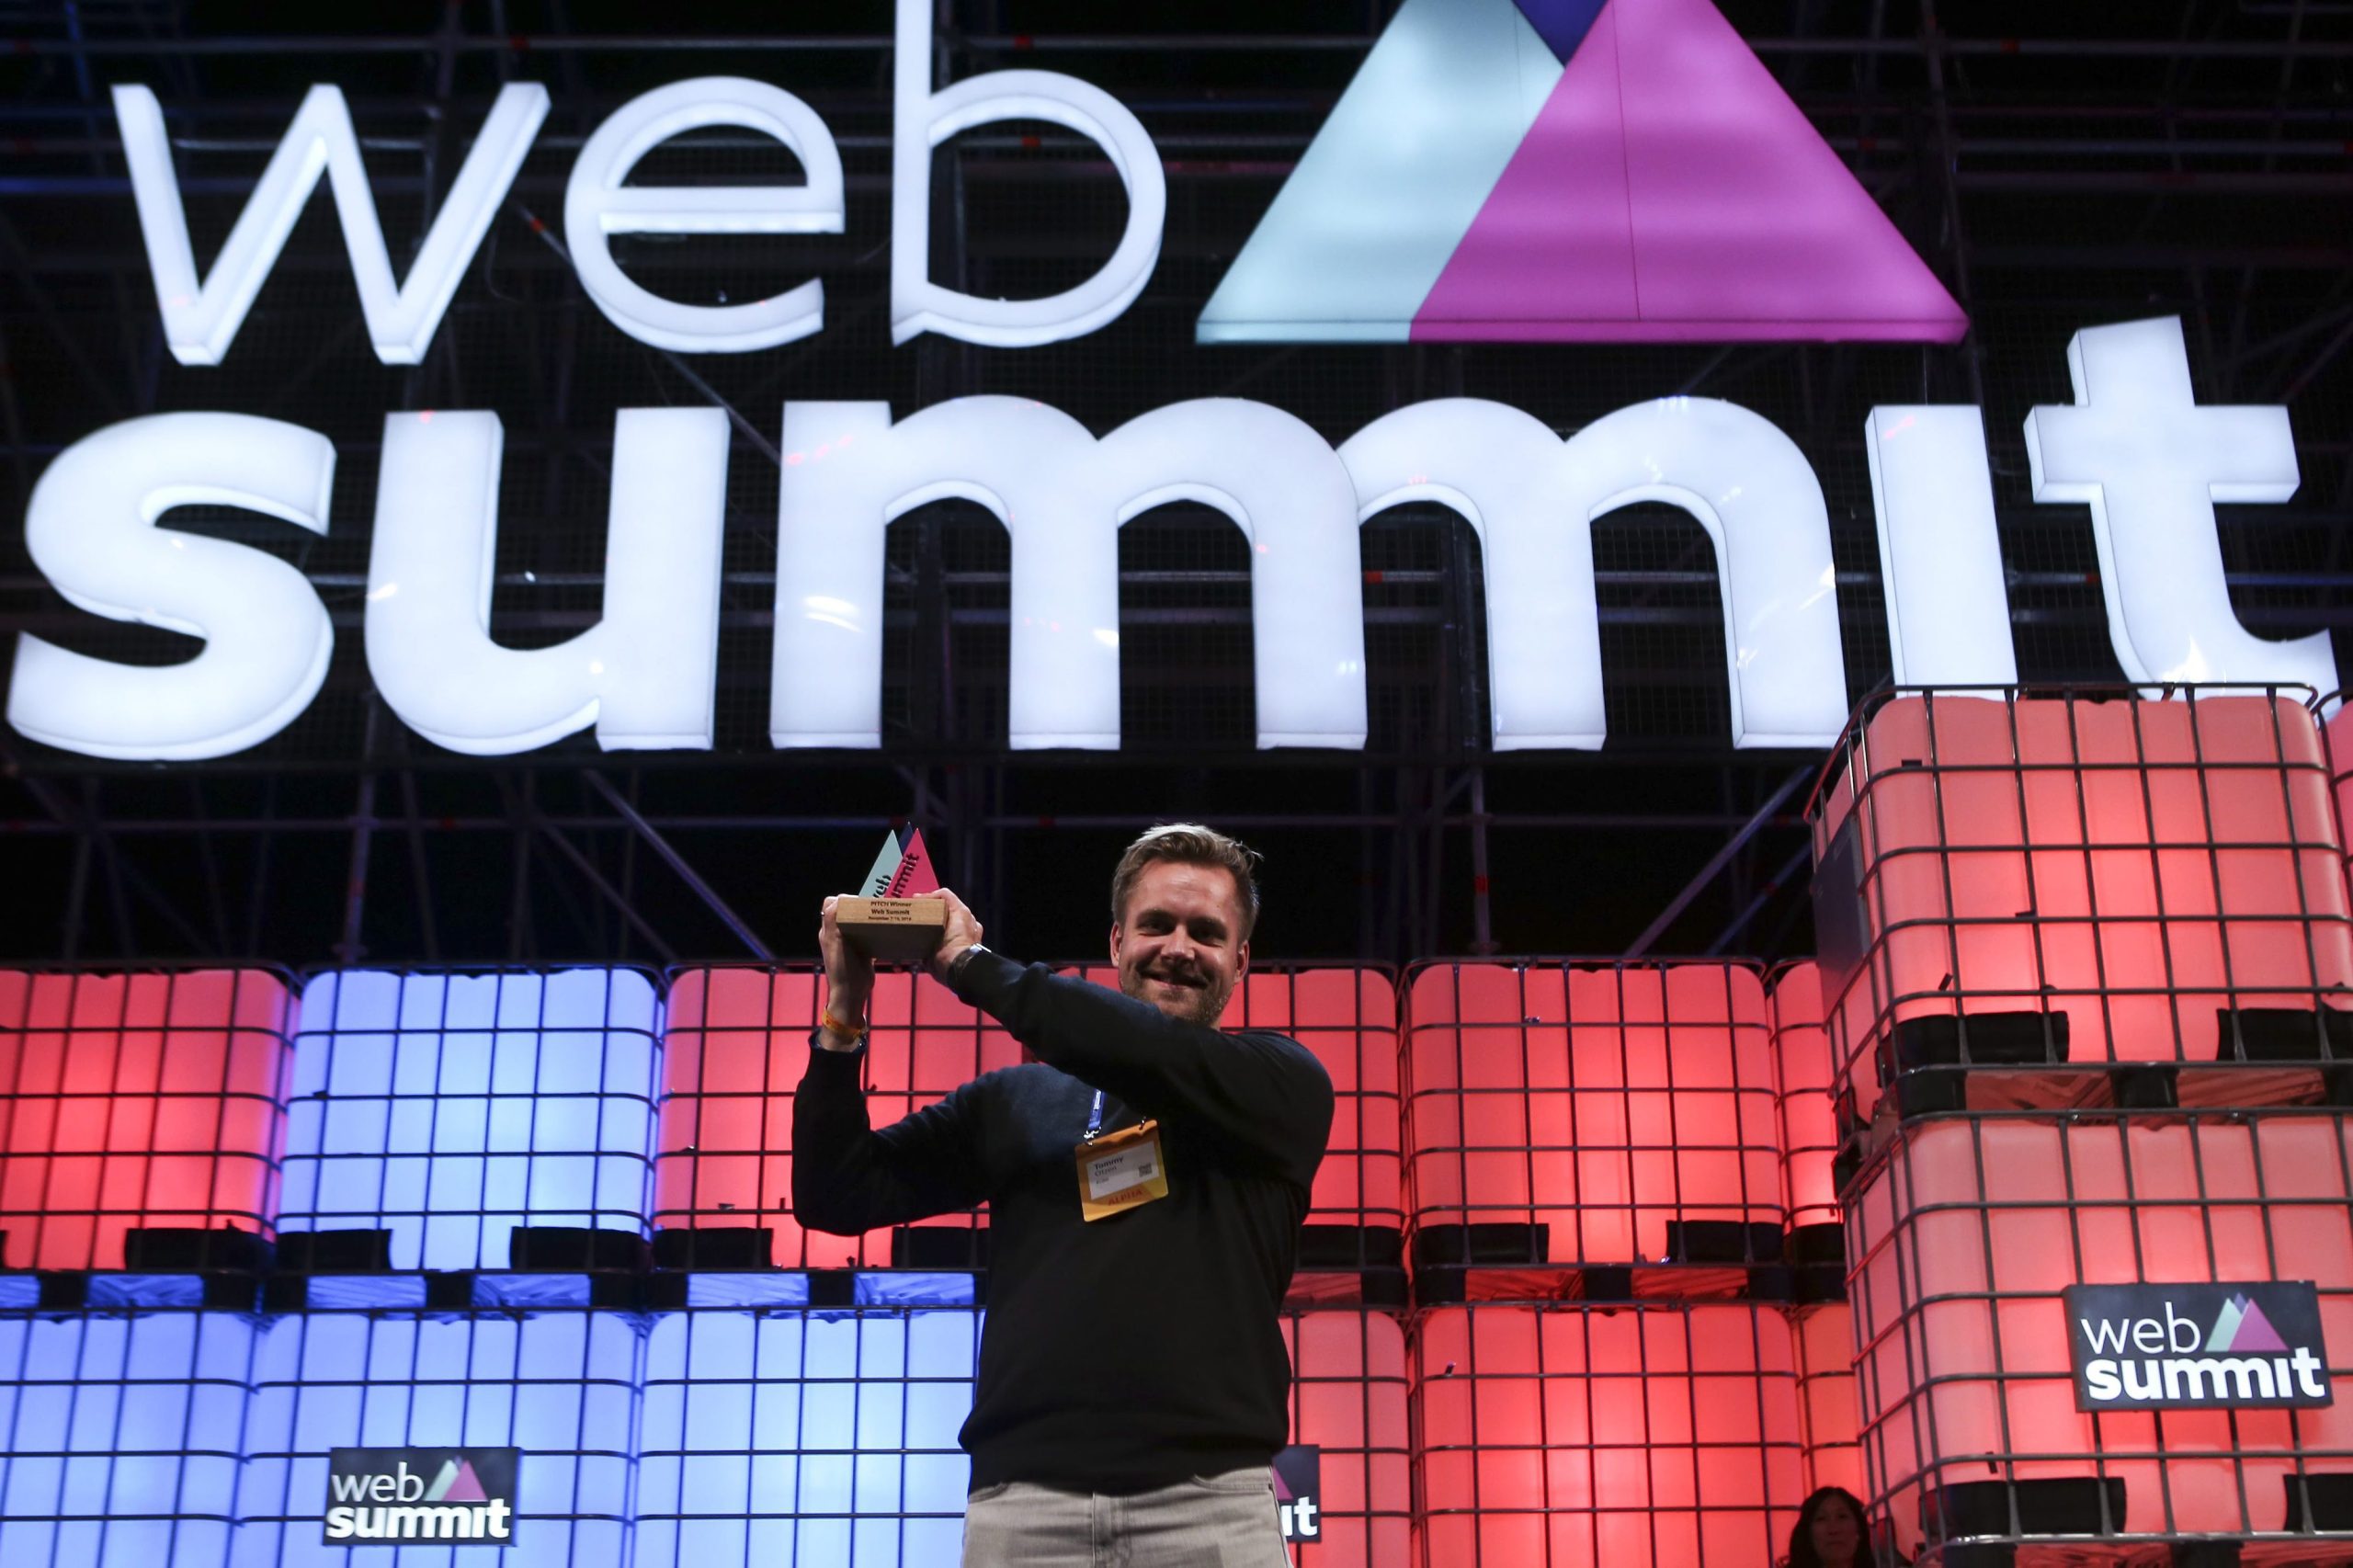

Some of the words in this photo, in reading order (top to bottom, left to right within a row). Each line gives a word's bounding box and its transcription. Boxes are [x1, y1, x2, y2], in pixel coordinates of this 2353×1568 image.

[111, 0, 1166, 365] web
[6, 314, 2340, 761] summit
[1095, 1156, 1124, 1170] Tommy
[2081, 1301, 2200, 1354] web
[2086, 1346, 2325, 1400] summit
[331, 1461, 424, 1502] web
[325, 1498, 510, 1538] summit
